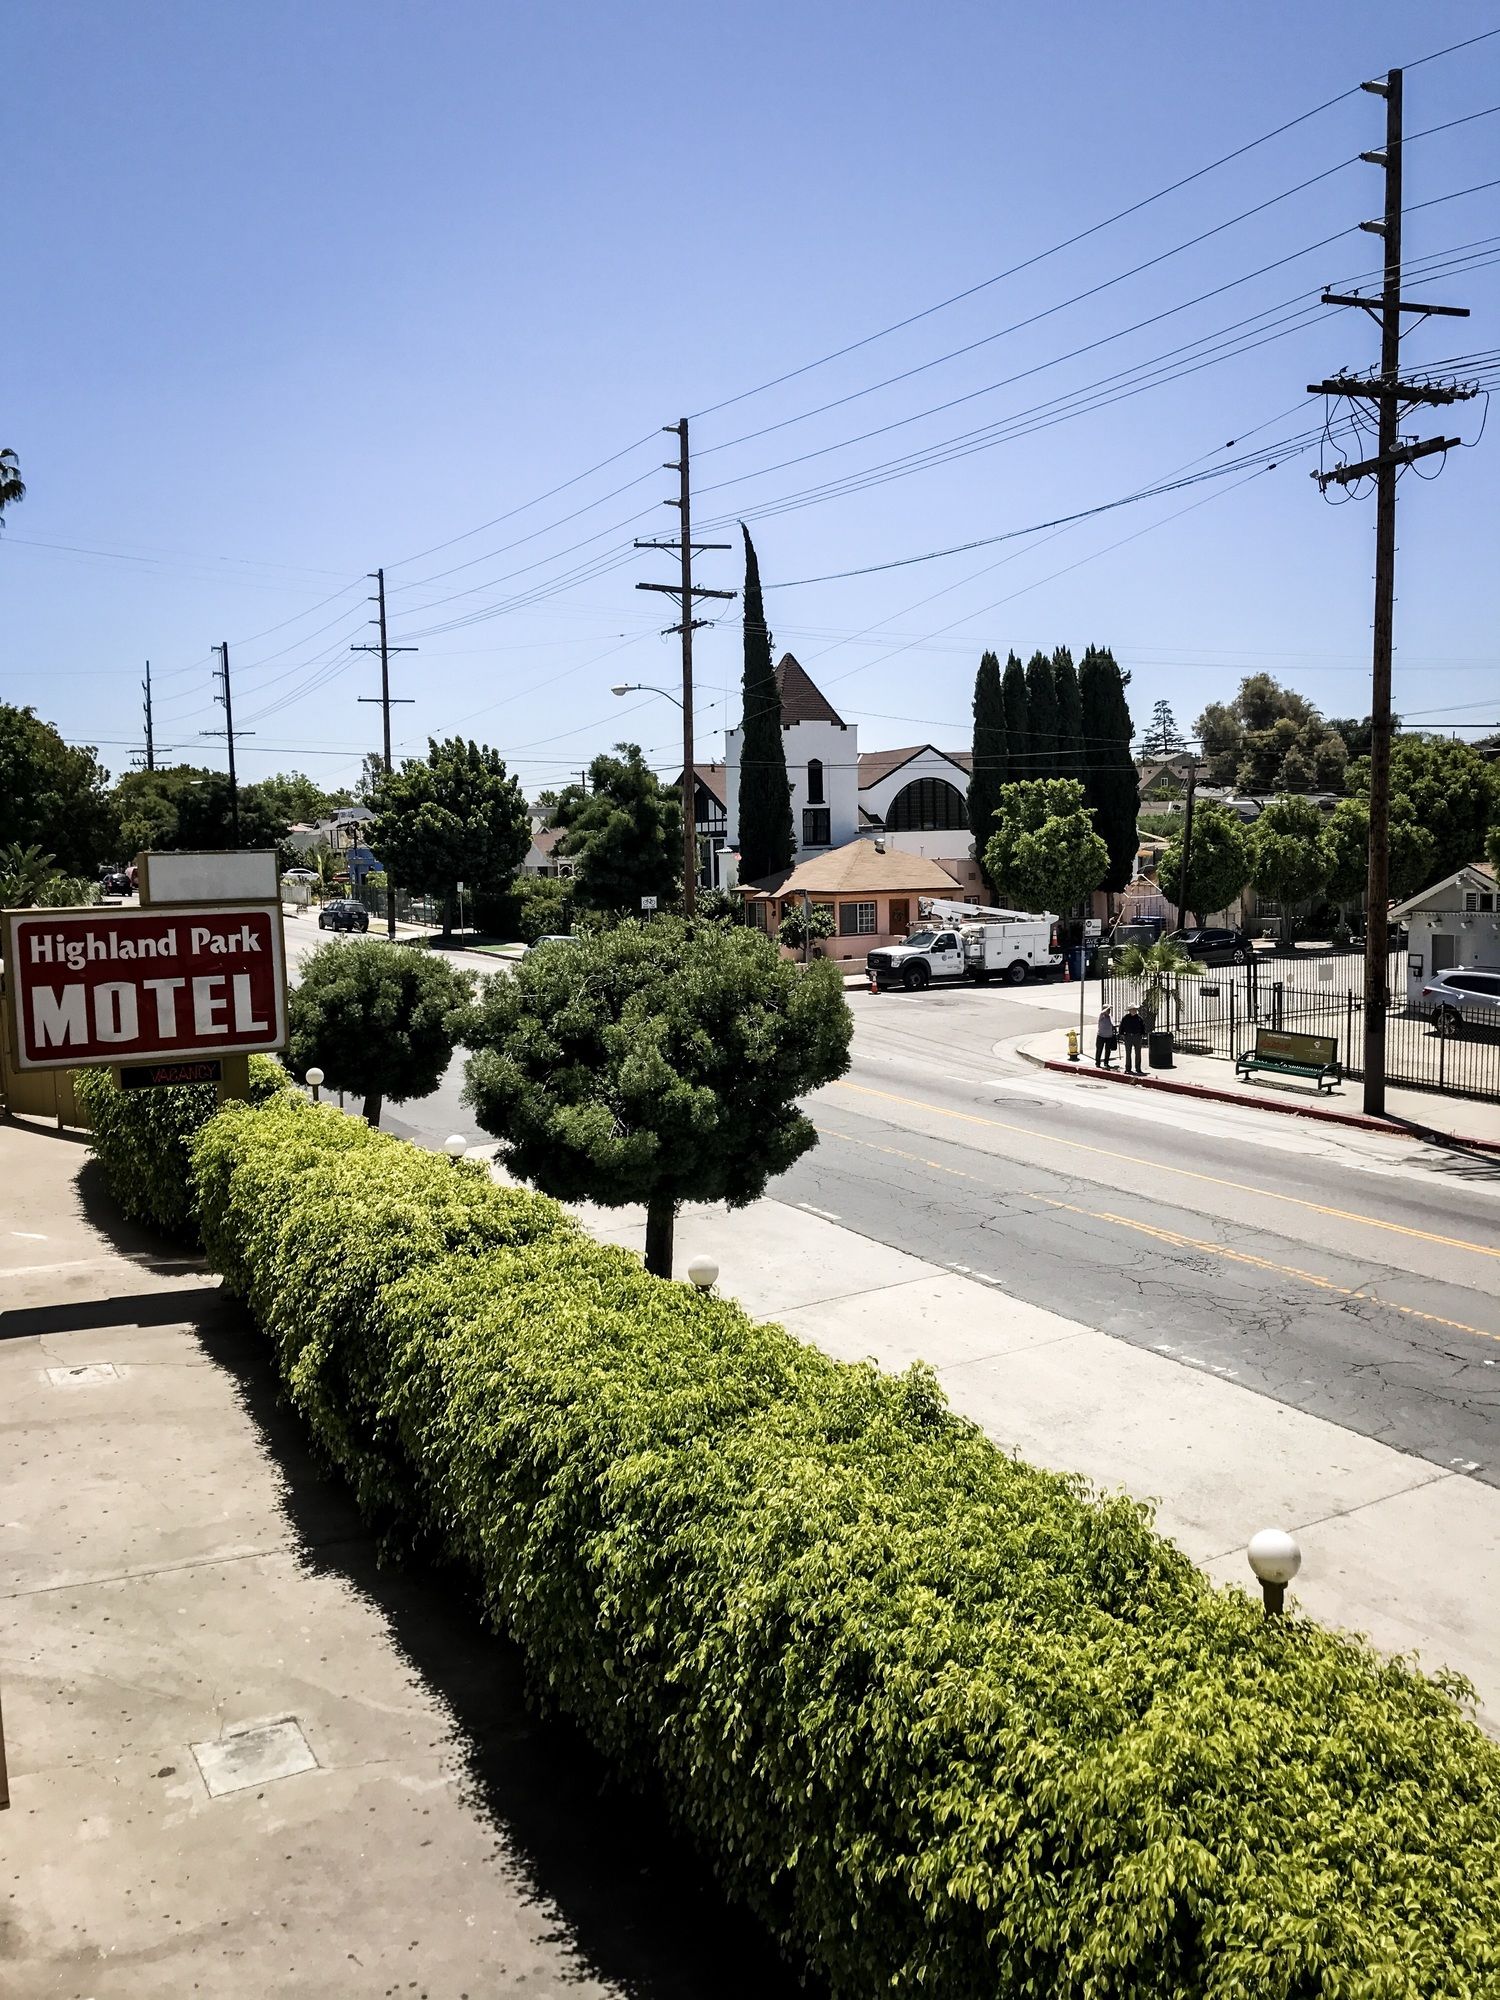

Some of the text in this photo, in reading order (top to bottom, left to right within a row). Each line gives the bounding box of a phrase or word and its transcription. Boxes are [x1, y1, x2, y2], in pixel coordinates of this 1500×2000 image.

[29, 925, 262, 971] Highland Park
[31, 973, 269, 1048] MOTEL
[152, 1064, 217, 1083] VACANCY
